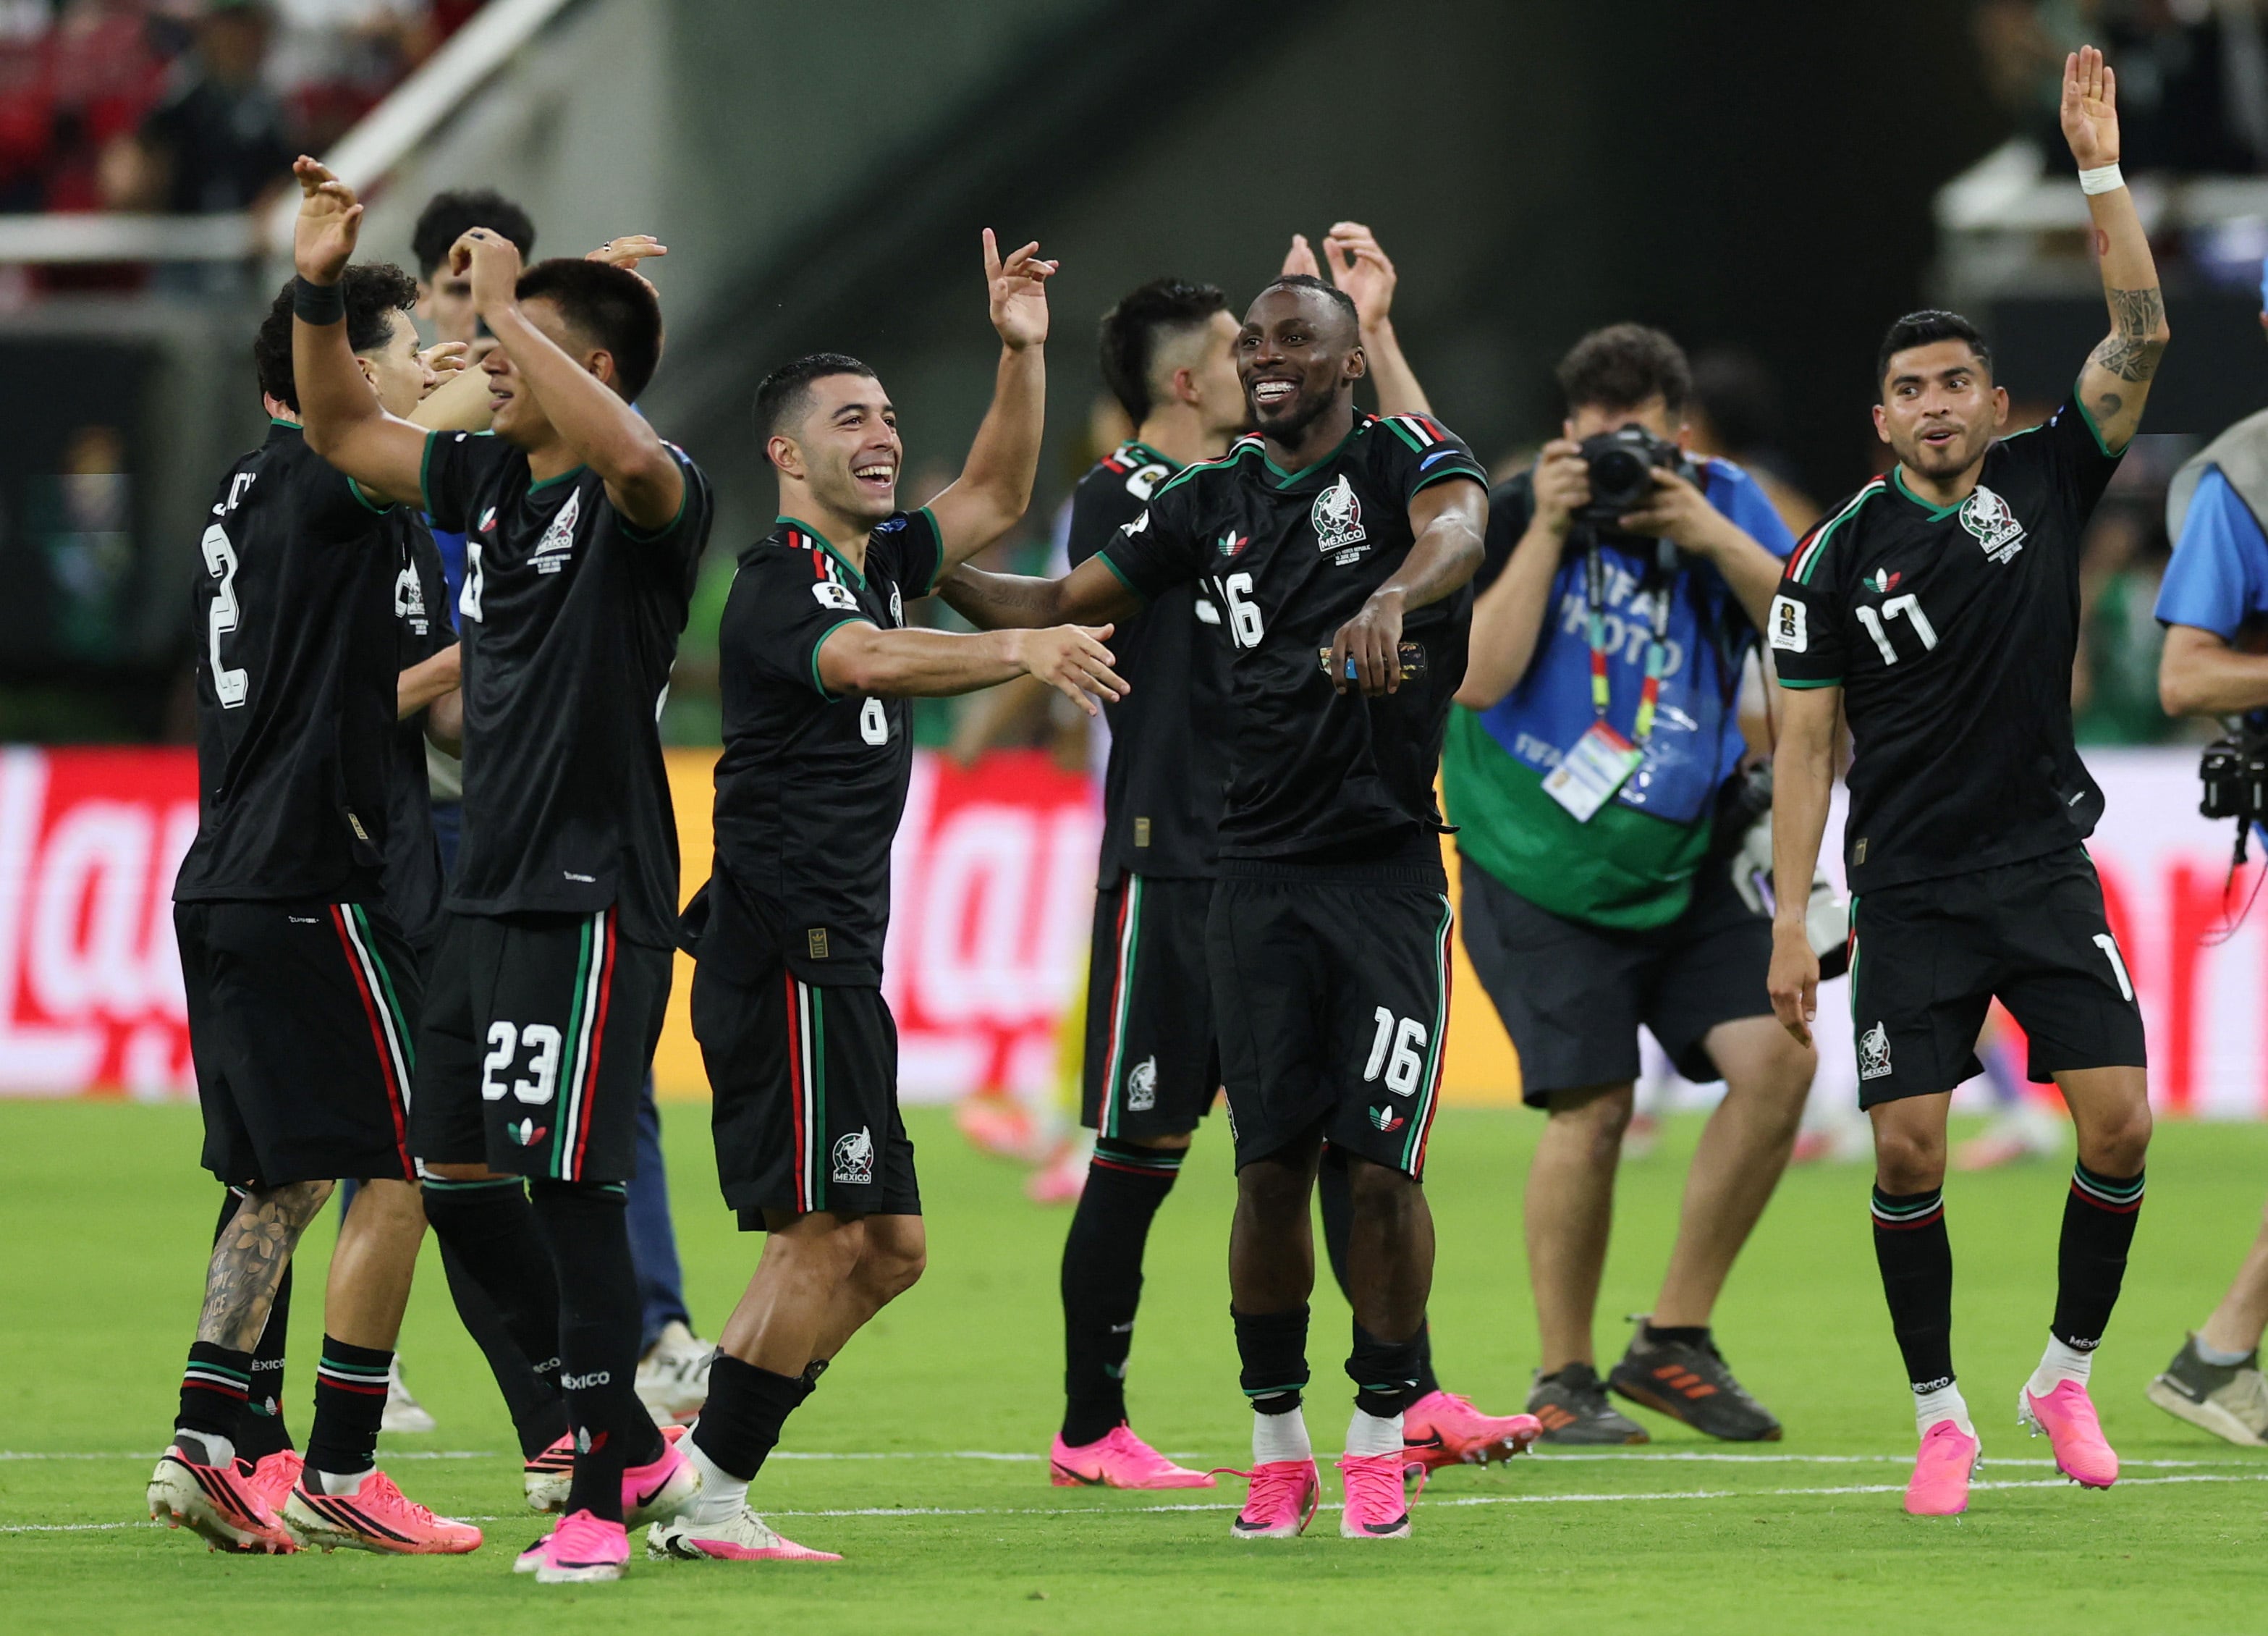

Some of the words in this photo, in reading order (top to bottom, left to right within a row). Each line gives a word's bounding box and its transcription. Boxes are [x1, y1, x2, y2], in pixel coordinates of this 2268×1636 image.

[1320, 528, 1363, 549] MÉXICO
[1984, 523, 2019, 550] MÉXICO
[200, 523, 249, 709] 2
[1854, 593, 1939, 665] 17
[481, 1021, 562, 1105] 23
[1363, 1006, 1428, 1097] 16
[835, 1171, 870, 1182] MÉXICO
[250, 1358, 286, 1372] ÉXICO
